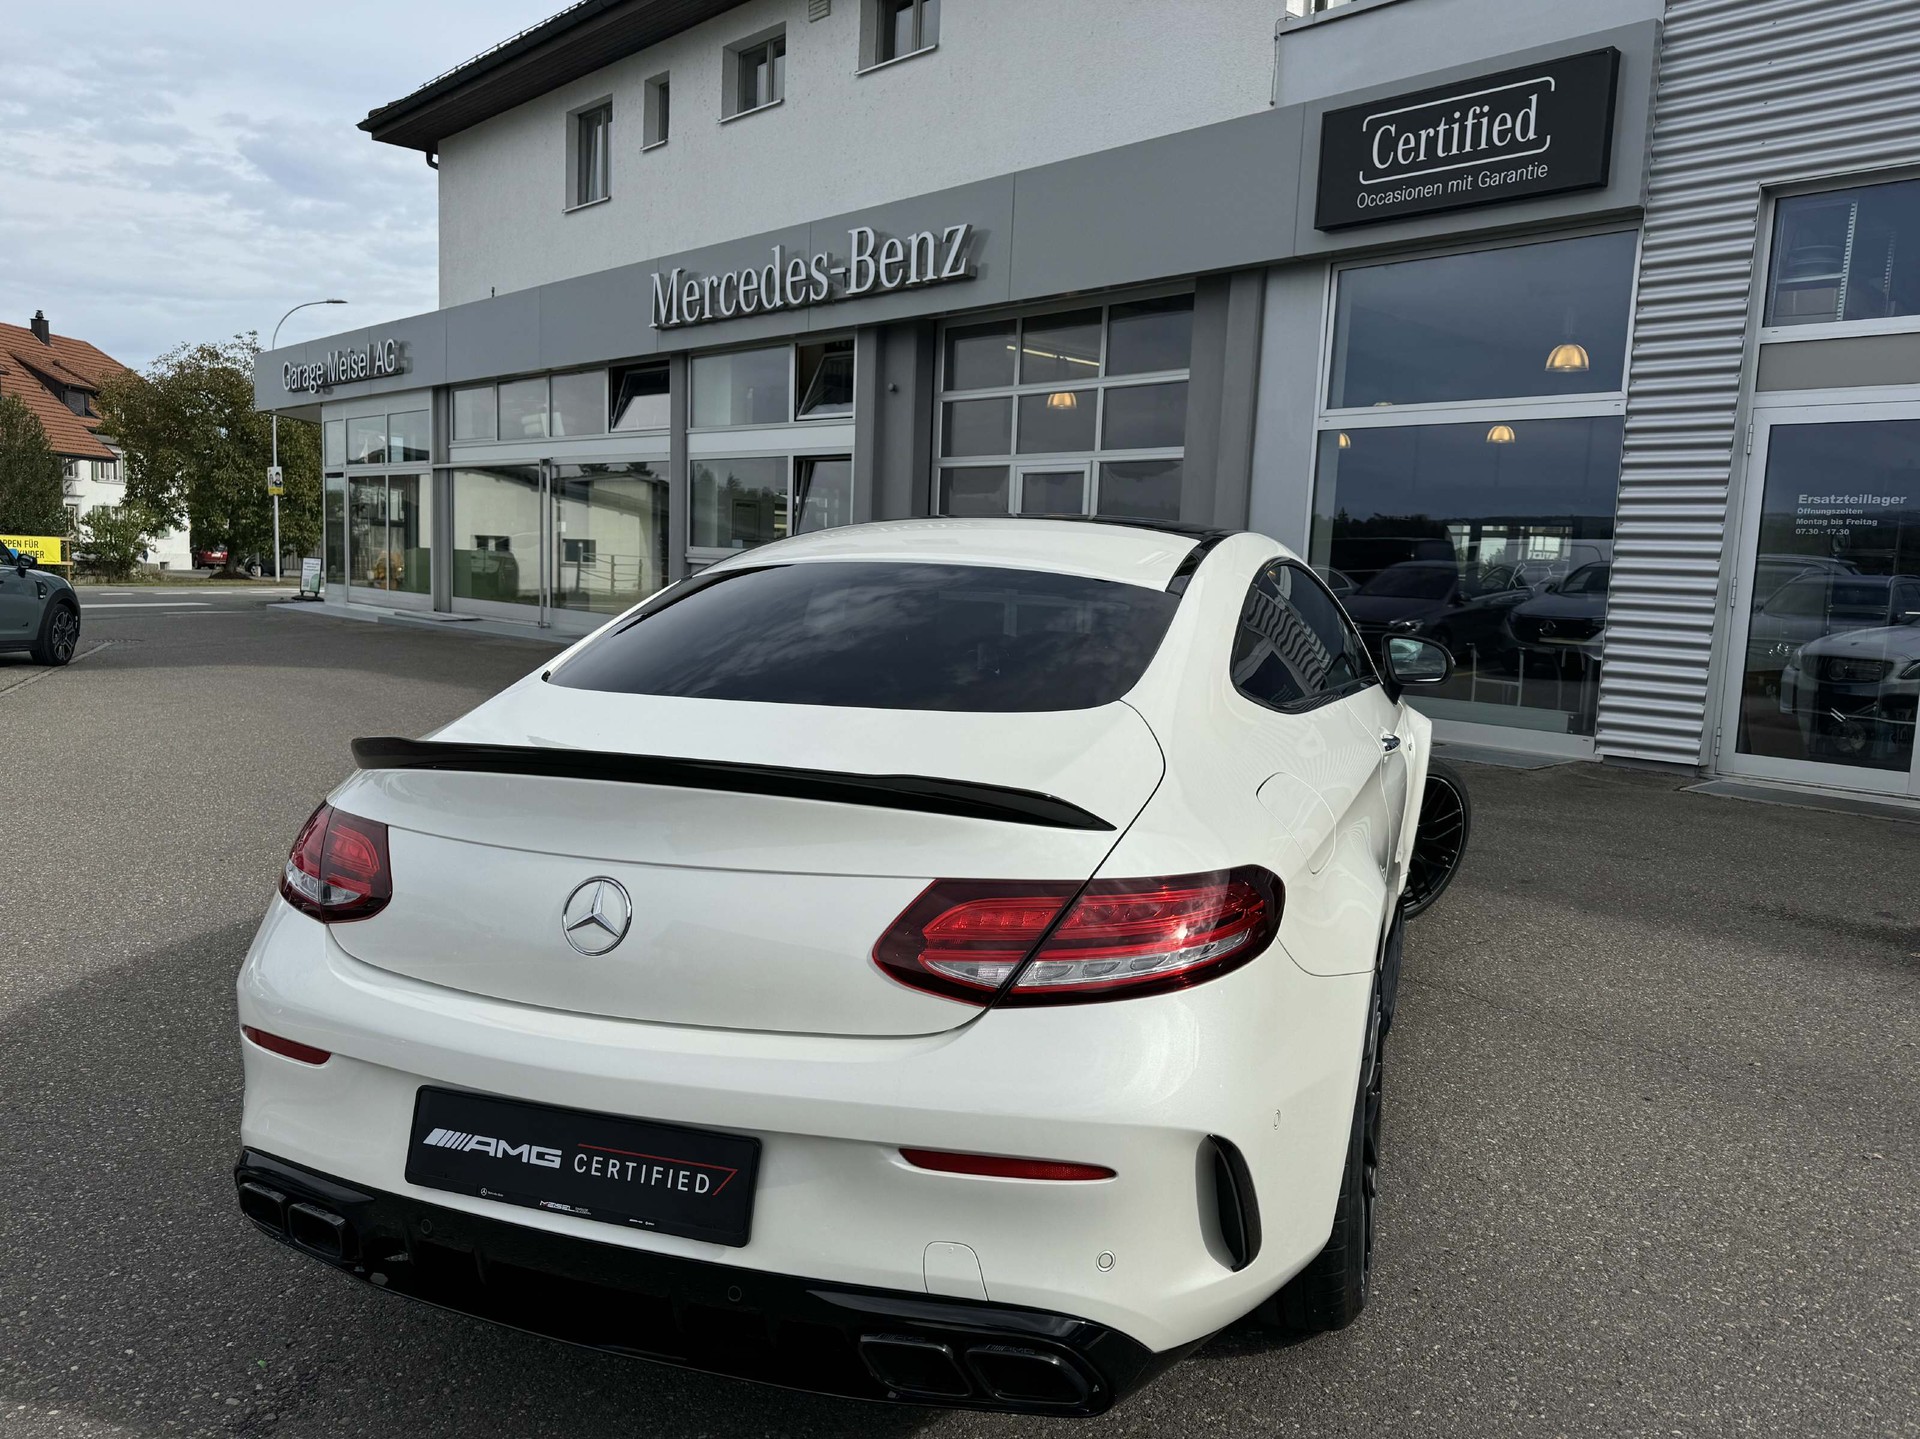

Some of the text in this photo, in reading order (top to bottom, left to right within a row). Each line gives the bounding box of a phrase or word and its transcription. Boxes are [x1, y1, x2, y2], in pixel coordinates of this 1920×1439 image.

[1372, 93, 1538, 169] Certified
[1357, 161, 1549, 209] Occasionen mit Garantie
[649, 223, 973, 328] Mercedes-Benz
[282, 338, 396, 394] Garage Meisel AG
[1795, 518, 1828, 526] Montag
[1846, 518, 1878, 526] Freitag
[1798, 494, 1907, 507] Ersatzteillager
[24, 539, 39, 549] FÜR
[573, 1153, 711, 1195] CERTIFIED
